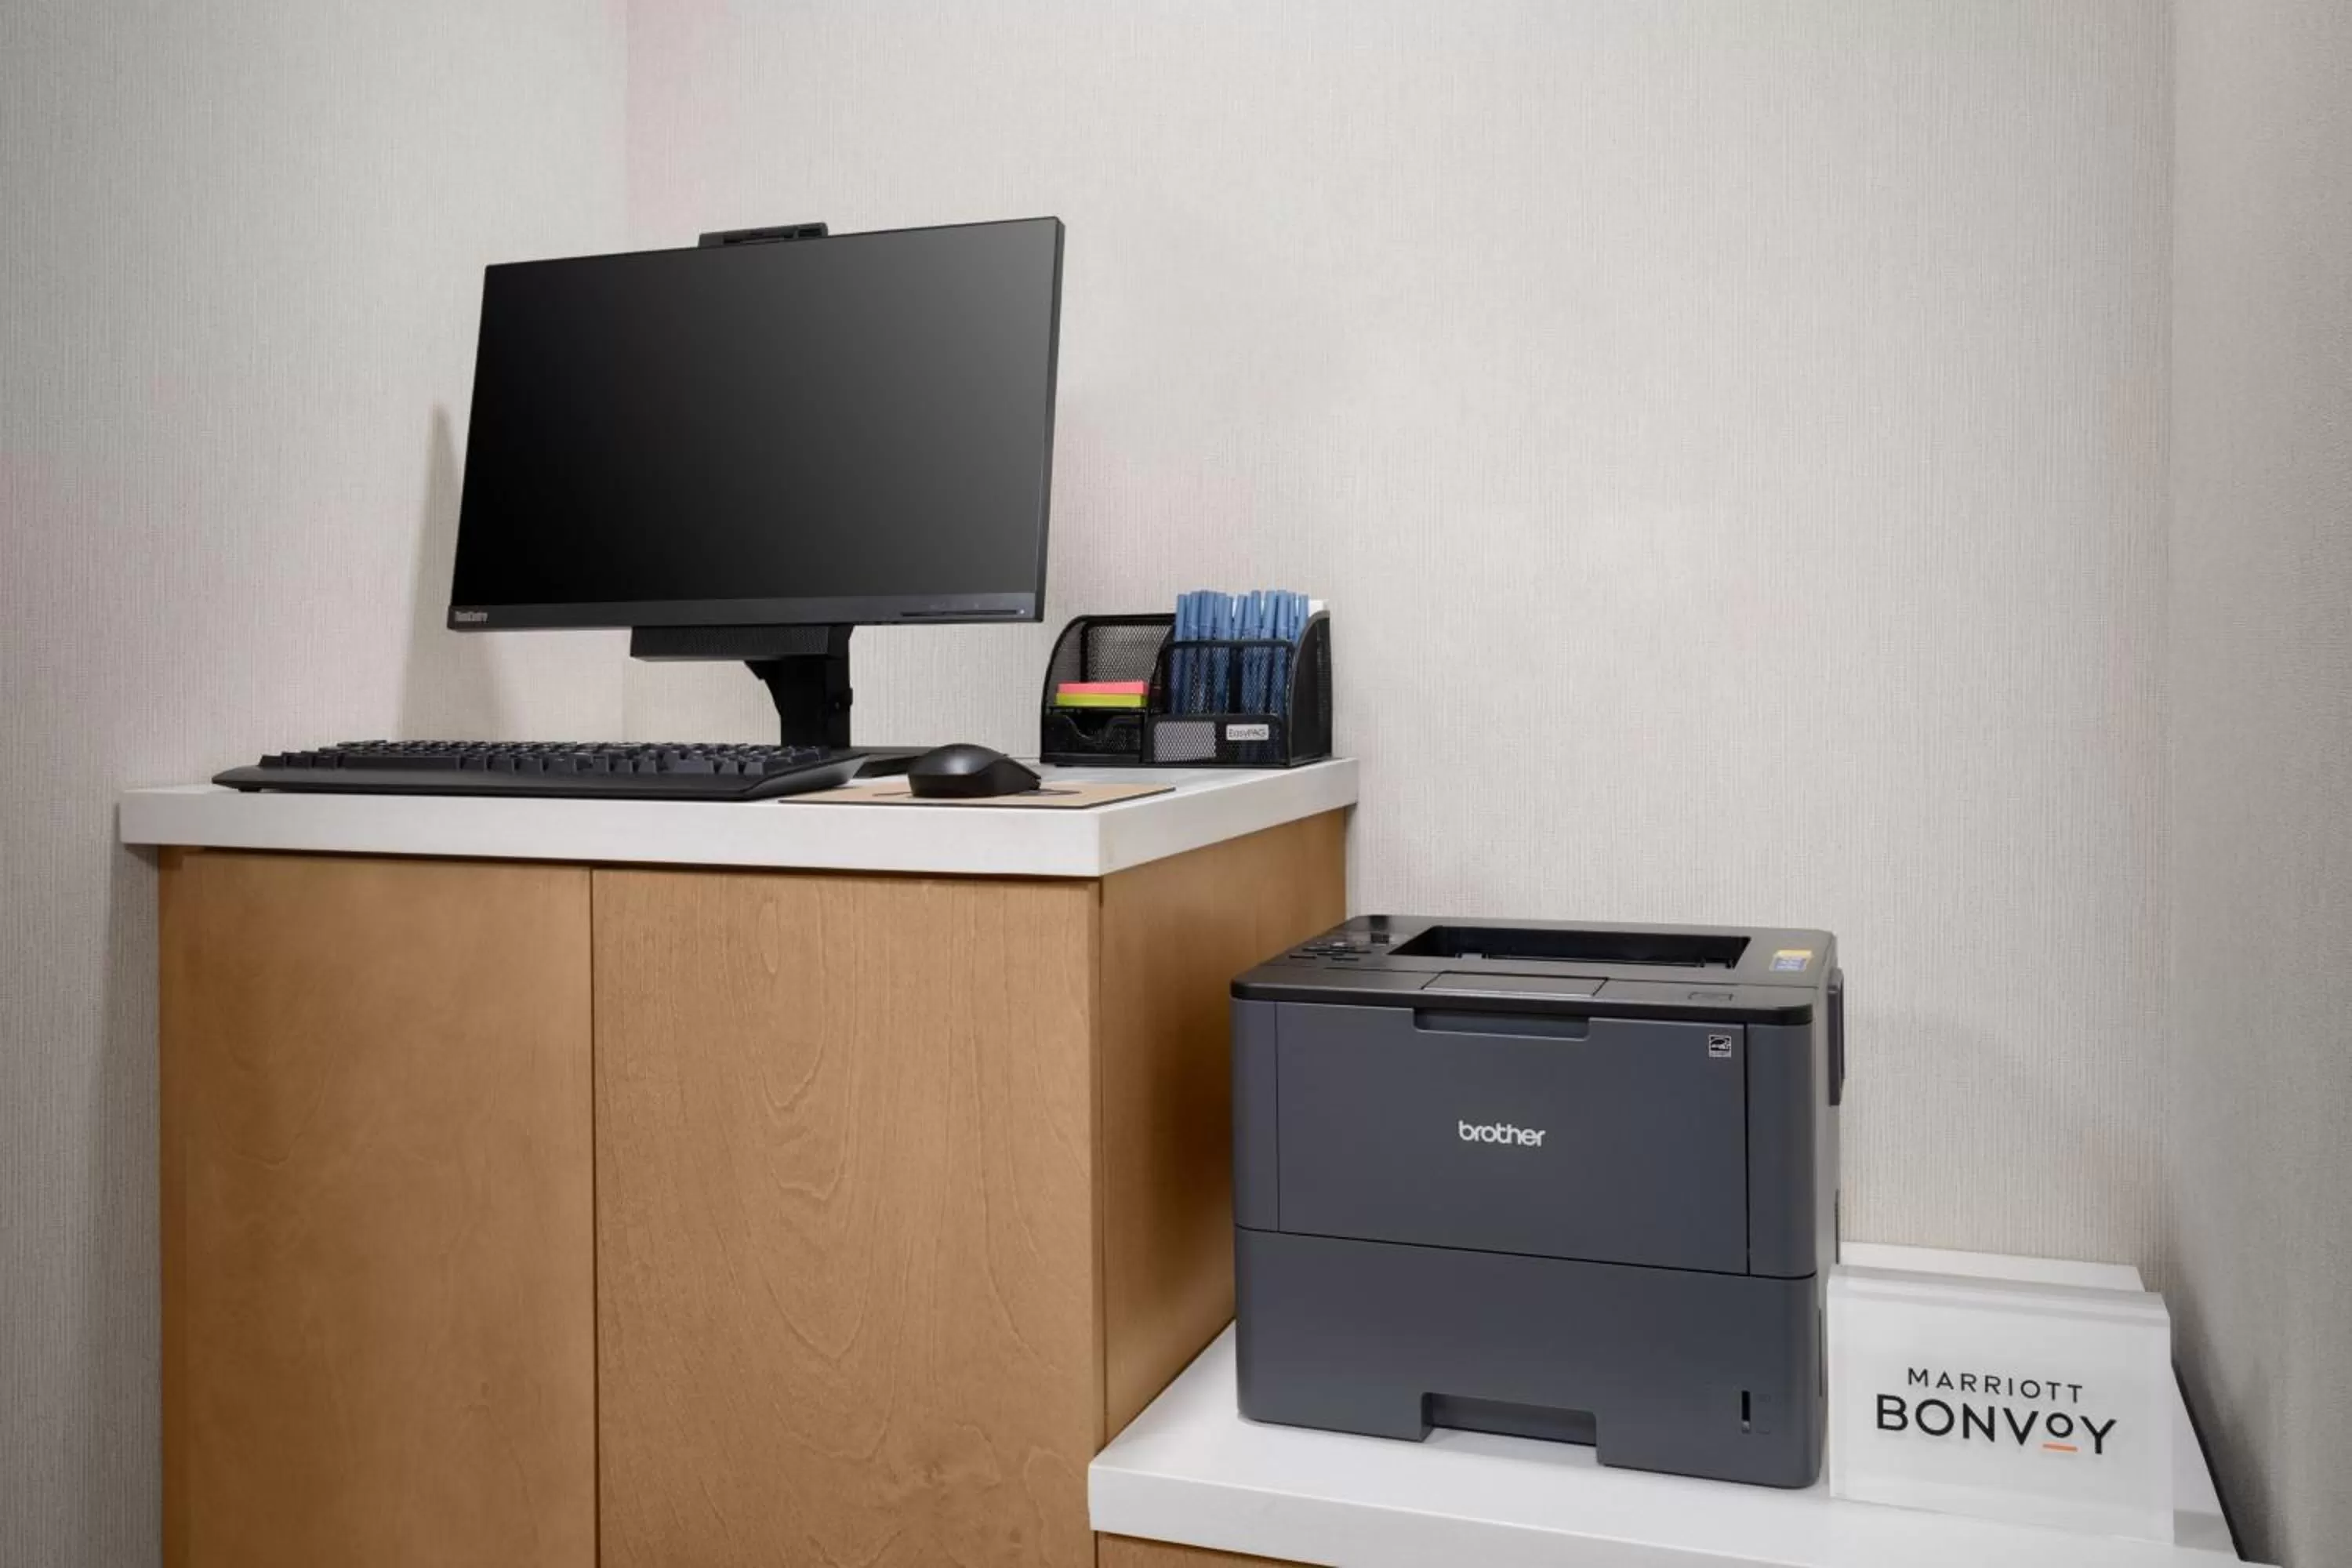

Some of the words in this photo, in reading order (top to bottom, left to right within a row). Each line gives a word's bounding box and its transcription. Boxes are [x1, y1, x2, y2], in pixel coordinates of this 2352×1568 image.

[1459, 1120, 1546, 1147] brother
[1907, 1367, 2083, 1403] MARRIOTT
[1876, 1393, 2117, 1454] BONVOY
